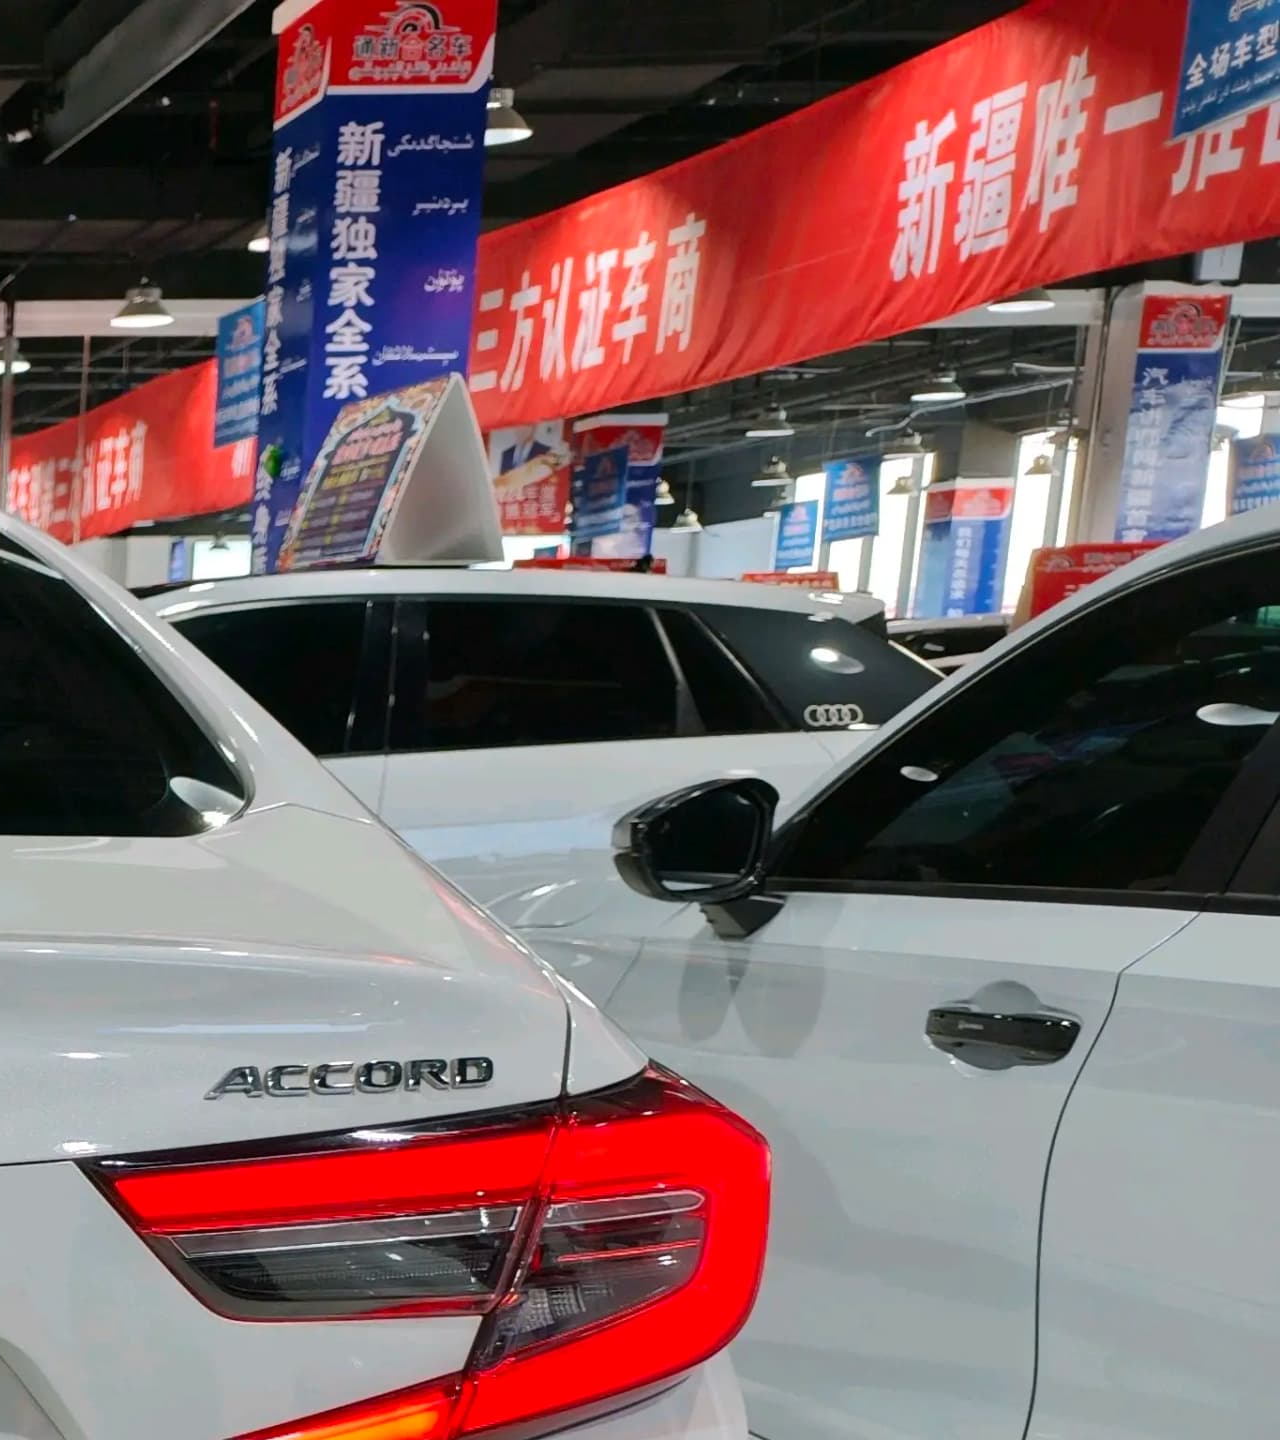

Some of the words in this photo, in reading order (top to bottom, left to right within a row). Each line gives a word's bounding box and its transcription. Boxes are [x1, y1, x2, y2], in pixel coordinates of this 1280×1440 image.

[1185, 20, 1280, 91] 全场车型
[322, 121, 385, 399] 新疆独家全系
[468, 212, 708, 394] 三方认证车商
[204, 1056, 494, 1101] ACCORD
